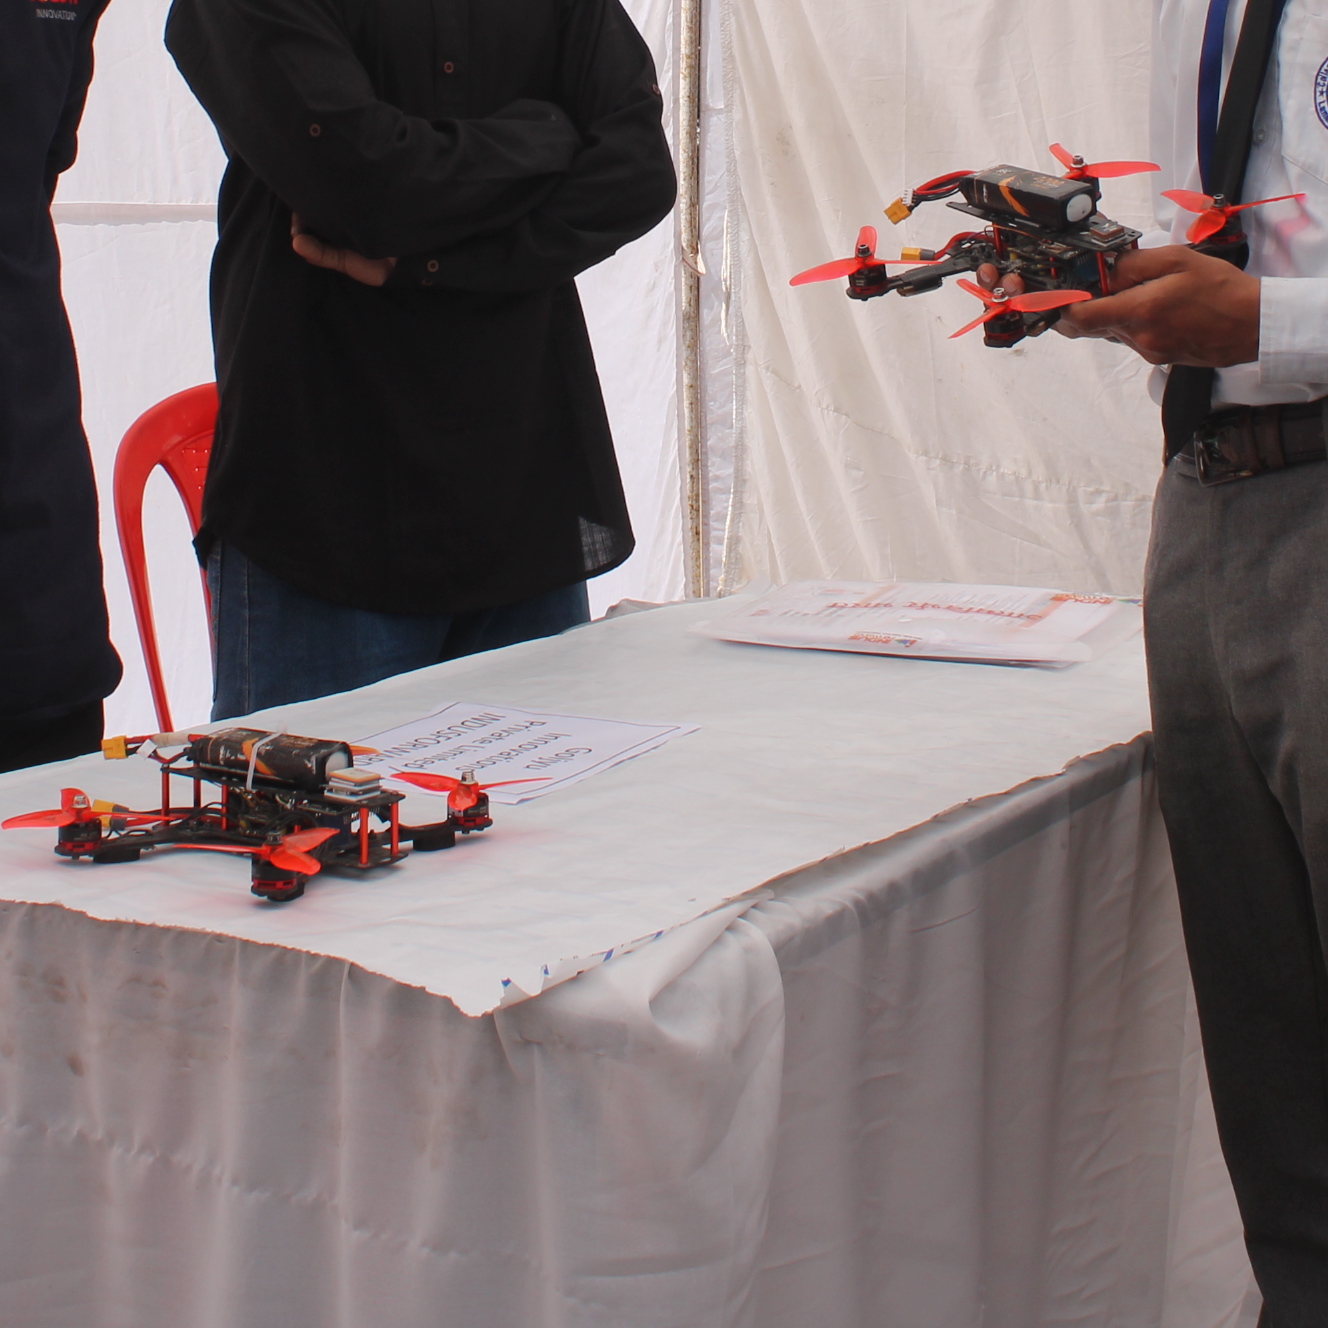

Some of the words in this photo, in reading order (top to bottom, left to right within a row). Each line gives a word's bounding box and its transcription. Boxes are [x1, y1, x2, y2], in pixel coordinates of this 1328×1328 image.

[472, 720, 547, 751] Private
[402, 744, 473, 770] Limited
[454, 732, 571, 773] Innovations
